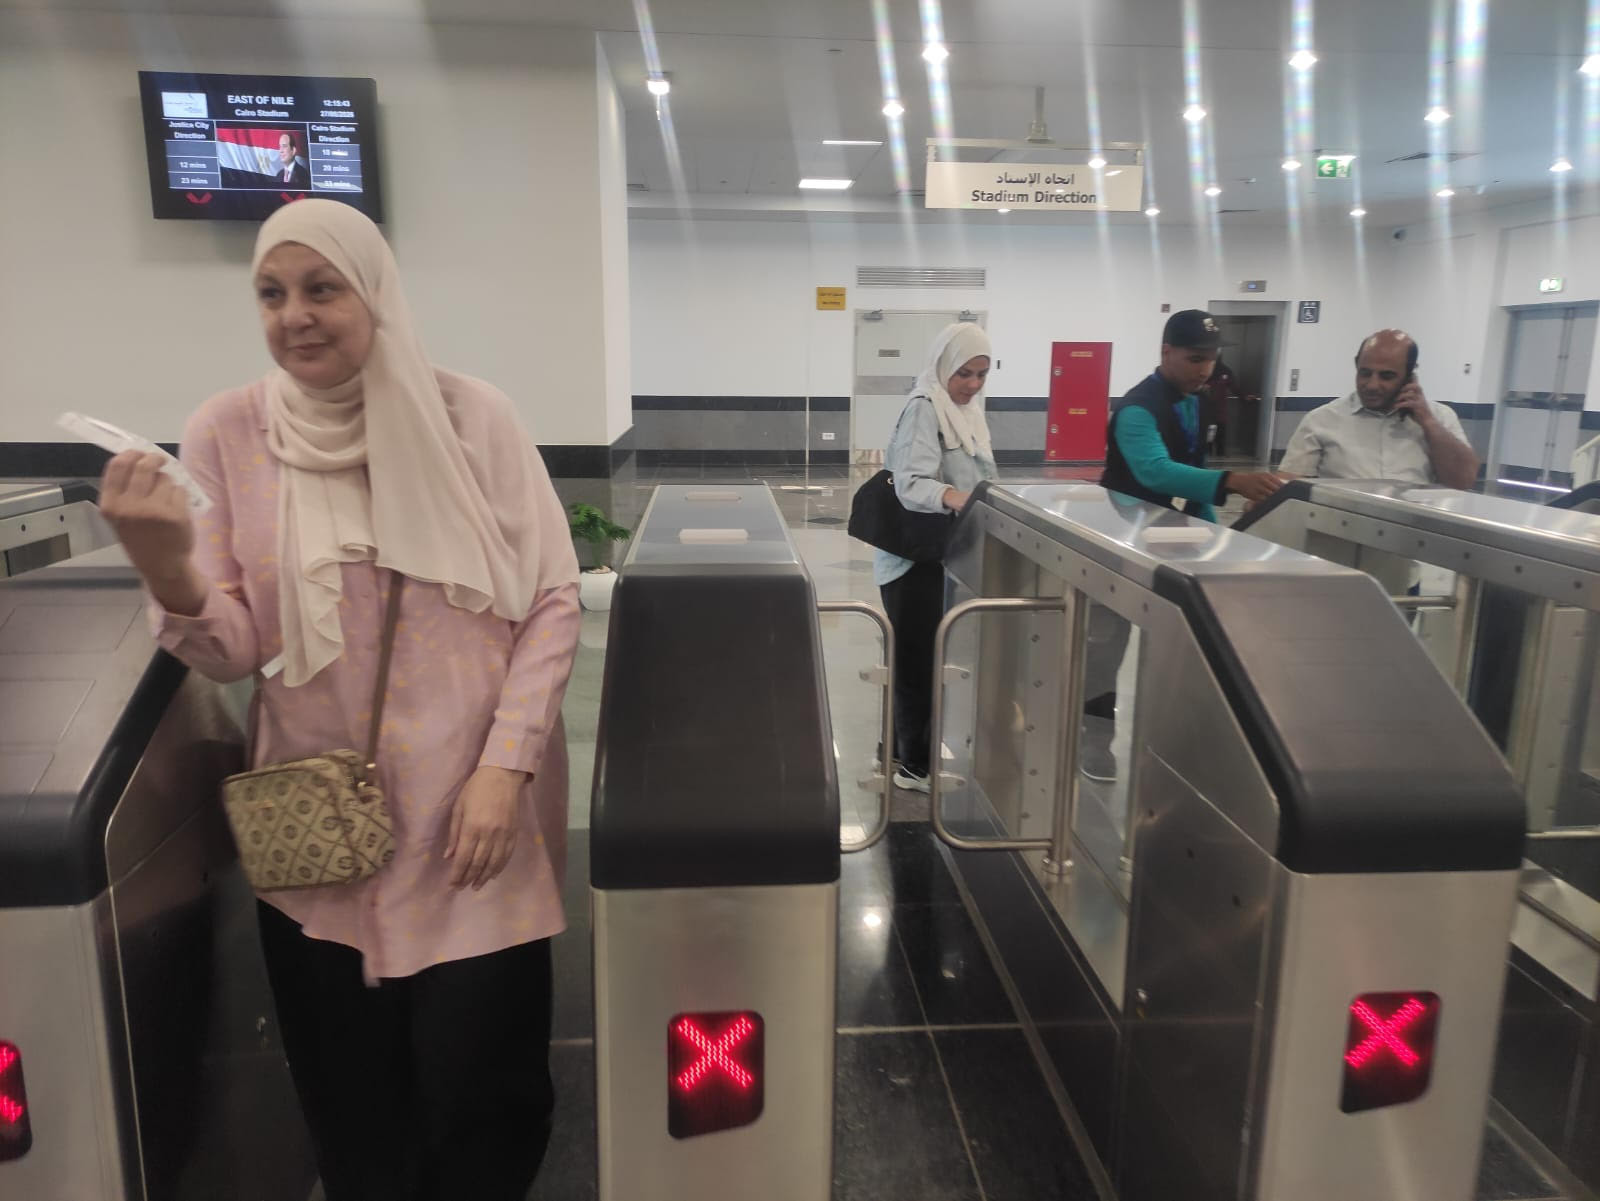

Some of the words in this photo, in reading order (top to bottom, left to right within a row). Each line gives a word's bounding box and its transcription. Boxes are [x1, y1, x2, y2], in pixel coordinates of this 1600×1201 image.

[227, 95, 254, 104] EAST
[255, 96, 270, 105] OF
[271, 96, 295, 106] NILE
[235, 109, 257, 117] Cairo
[257, 109, 289, 117] Stadium
[194, 122, 210, 130] City
[174, 131, 206, 139] Direction
[318, 135, 350, 143] Direction
[189, 161, 207, 169] mins
[332, 164, 350, 172] mins
[971, 189, 1029, 203] Stadium
[1034, 190, 1098, 204] Direction
